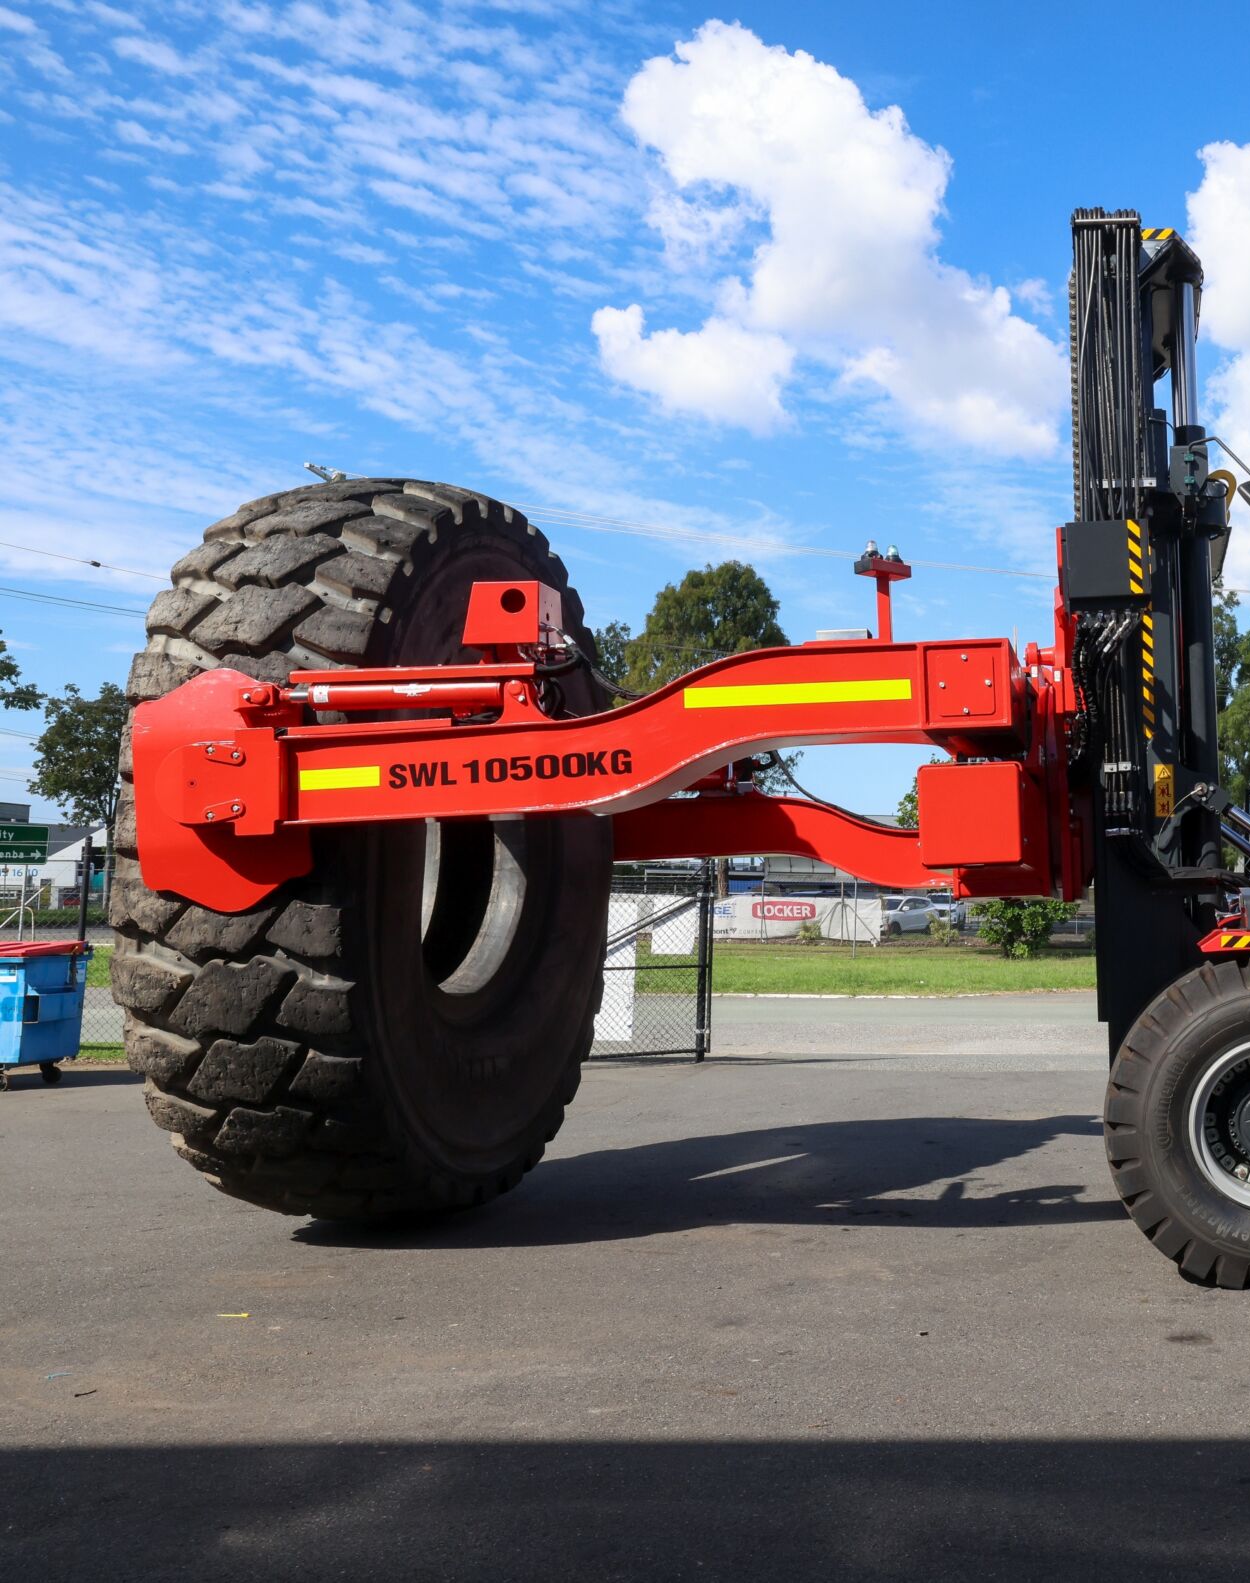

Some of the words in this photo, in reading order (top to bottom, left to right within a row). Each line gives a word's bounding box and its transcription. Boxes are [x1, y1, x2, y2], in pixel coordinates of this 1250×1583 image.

[389, 762, 457, 790] SWL
[462, 749, 632, 784] 10500KG
[756, 904, 812, 917] LOCKER
